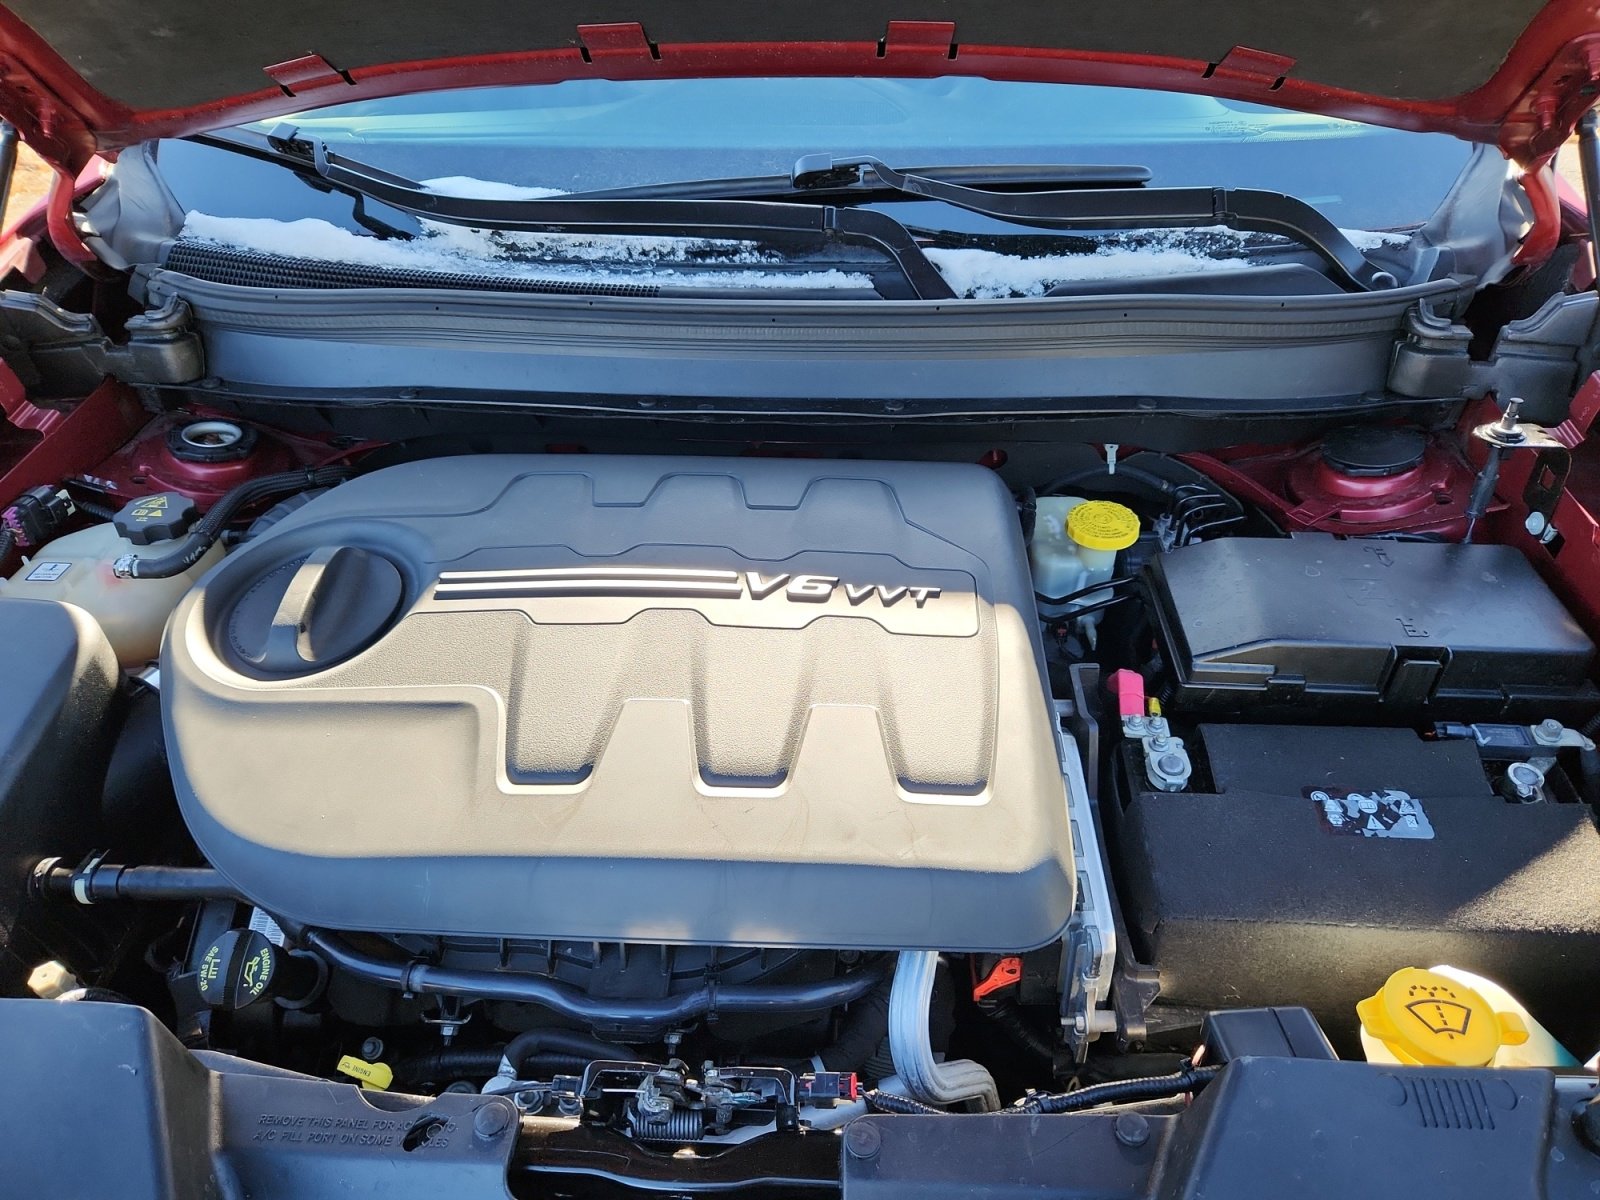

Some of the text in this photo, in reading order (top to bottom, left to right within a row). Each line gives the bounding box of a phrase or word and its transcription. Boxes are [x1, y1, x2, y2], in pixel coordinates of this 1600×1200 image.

[745, 572, 942, 608] V6 VVT
[204, 946, 219, 962] SAE
[249, 948, 271, 995] ENGINE OIL
[258, 1114, 306, 1126] REMOVE
[308, 1116, 333, 1128] THIS
[334, 1118, 369, 1130] PANEL
[372, 1120, 395, 1132] FOR
[252, 1128, 277, 1141] A/C
[280, 1131, 303, 1142] FILL
[306, 1132, 337, 1144] PORT
[340, 1133, 359, 1145] ON
[359, 1135, 393, 1147] SOME
